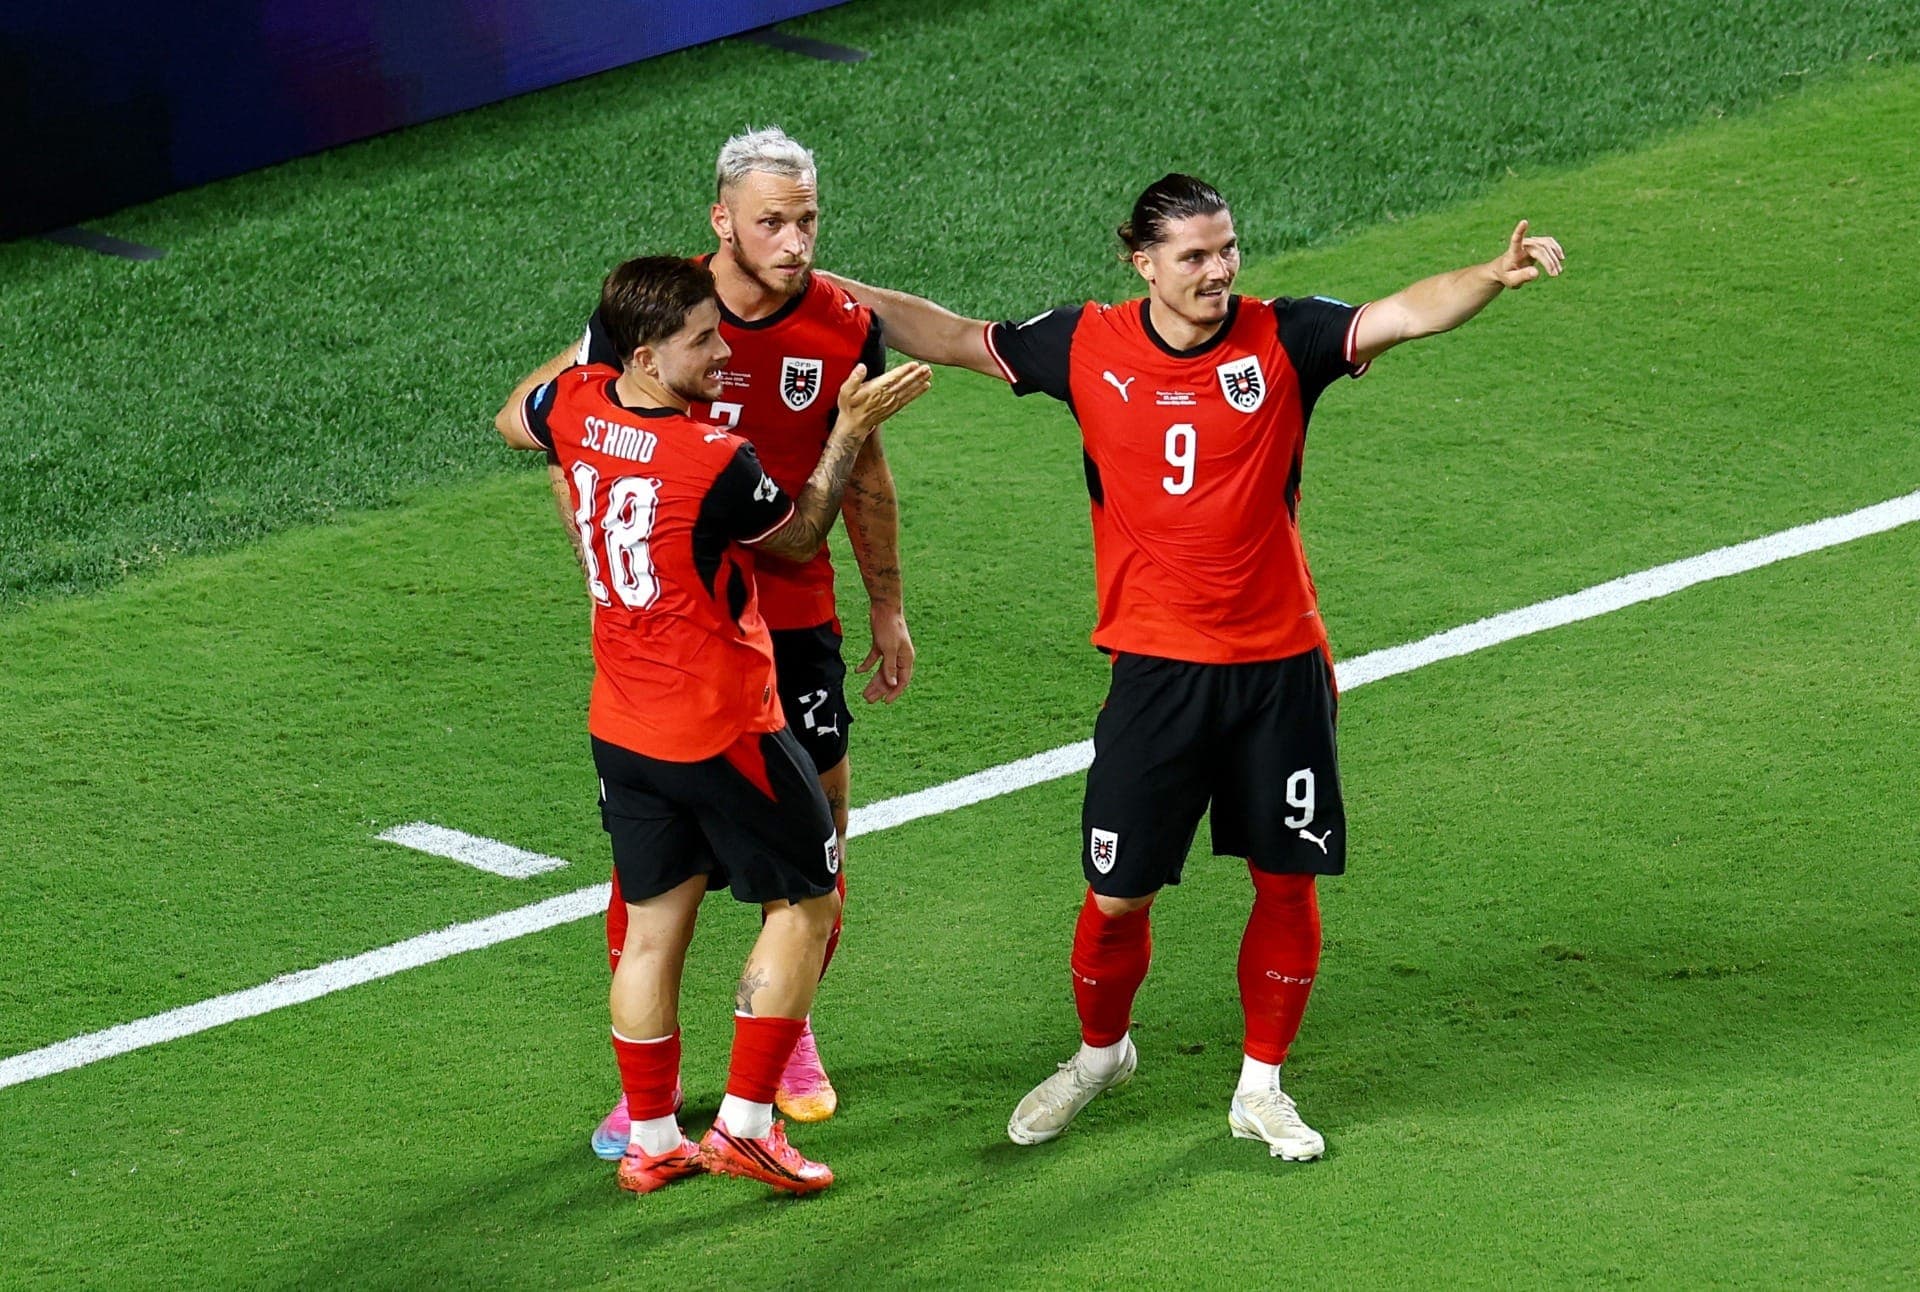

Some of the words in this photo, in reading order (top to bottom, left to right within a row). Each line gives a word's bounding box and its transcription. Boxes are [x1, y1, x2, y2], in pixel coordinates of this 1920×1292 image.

[581, 415, 658, 464] SCHMID
[1162, 423, 1197, 495] 9
[570, 460, 663, 611] 18
[1284, 767, 1315, 829] 9
